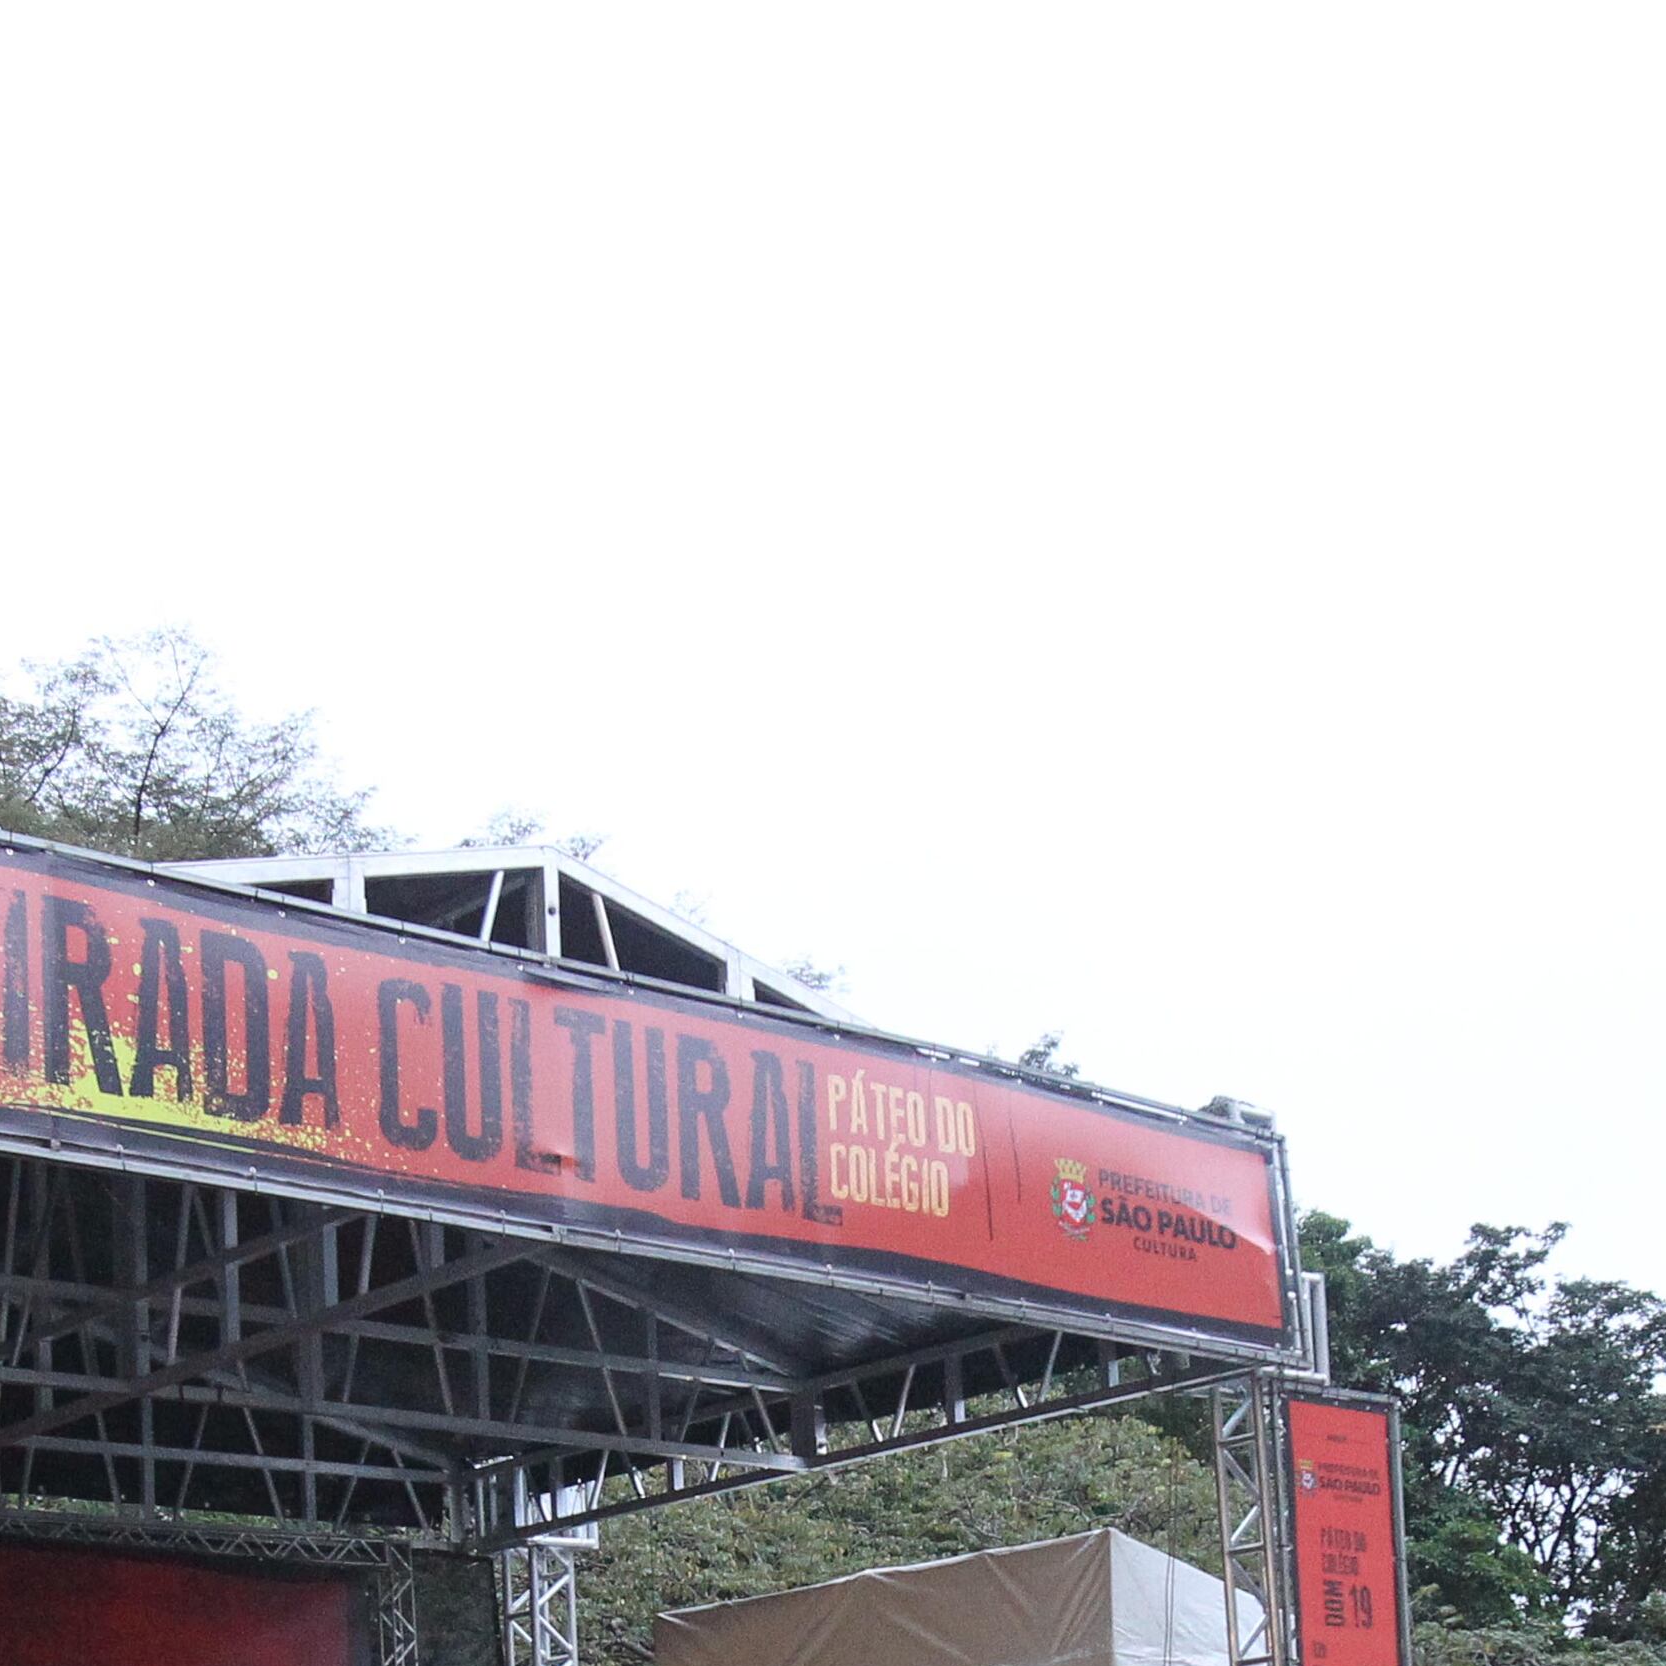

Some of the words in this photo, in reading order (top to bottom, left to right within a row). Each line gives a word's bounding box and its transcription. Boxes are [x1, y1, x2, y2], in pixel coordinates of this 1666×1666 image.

[378, 978, 843, 1226] CULTURAL
[828, 1069, 927, 1147] PÁTEO
[935, 1096, 976, 1158] DO
[830, 1134, 950, 1218] COLÉGIO
[1099, 1168, 1208, 1209] PREFEITURA
[1210, 1195, 1232, 1215] DE
[1101, 1195, 1153, 1232] SÃO
[1158, 1209, 1237, 1249] PAULO
[1133, 1236, 1198, 1261] CULTURA
[1349, 1584, 1373, 1629] 19
